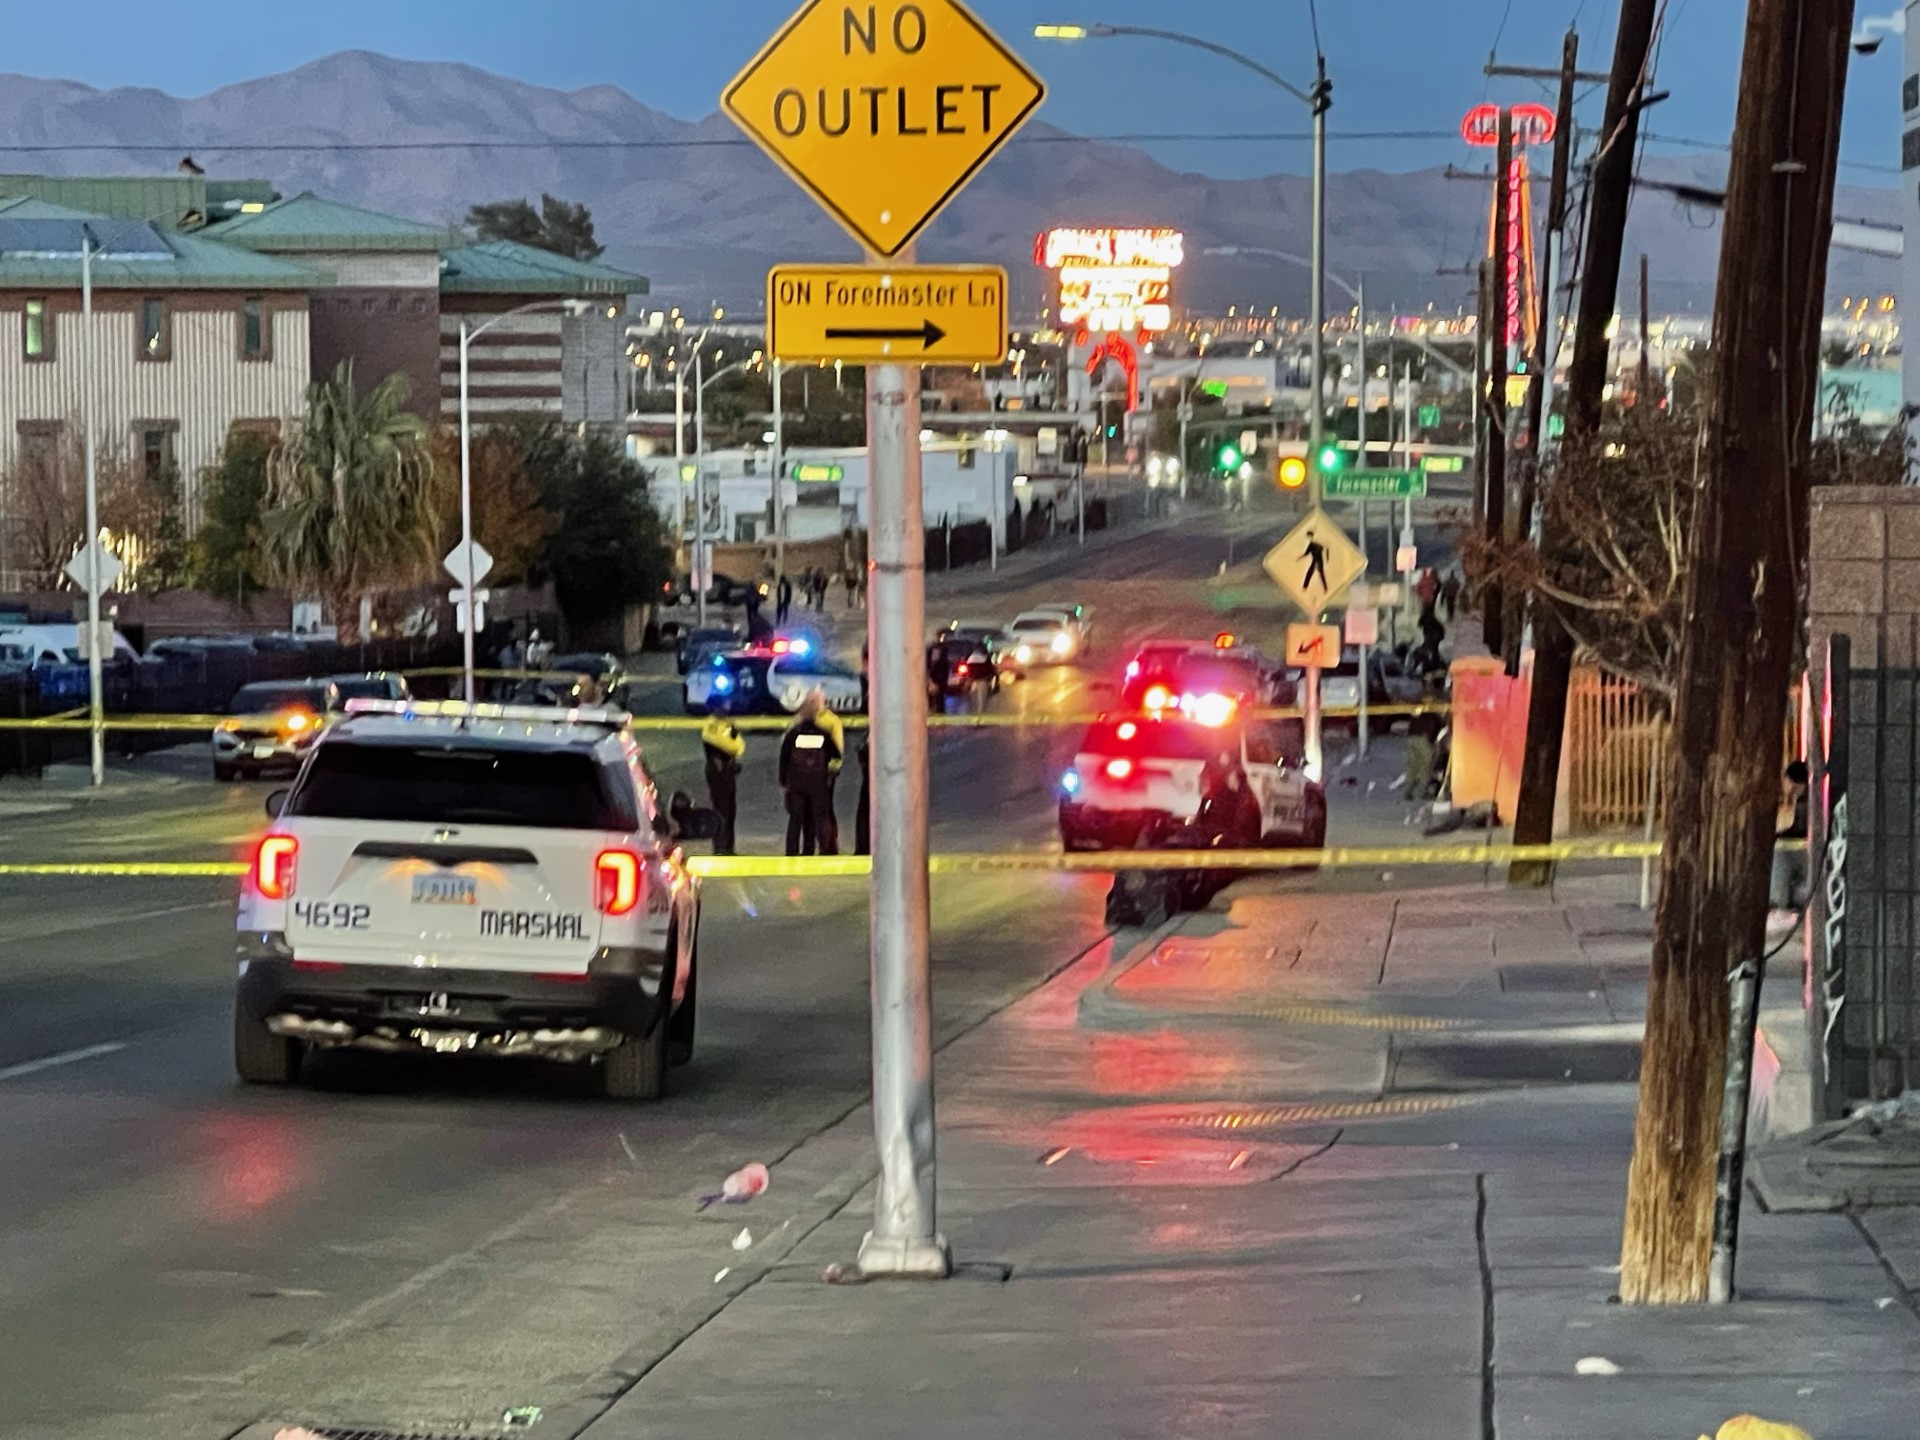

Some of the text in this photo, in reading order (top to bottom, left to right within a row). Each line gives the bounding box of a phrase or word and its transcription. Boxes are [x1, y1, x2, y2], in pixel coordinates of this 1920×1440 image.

[843, 4, 927, 55] NO
[773, 83, 1001, 137] OUTLET
[780, 279, 995, 307] ON Foremaster Ln
[295, 901, 371, 930] 4692
[480, 910, 591, 941] MARSHAL
